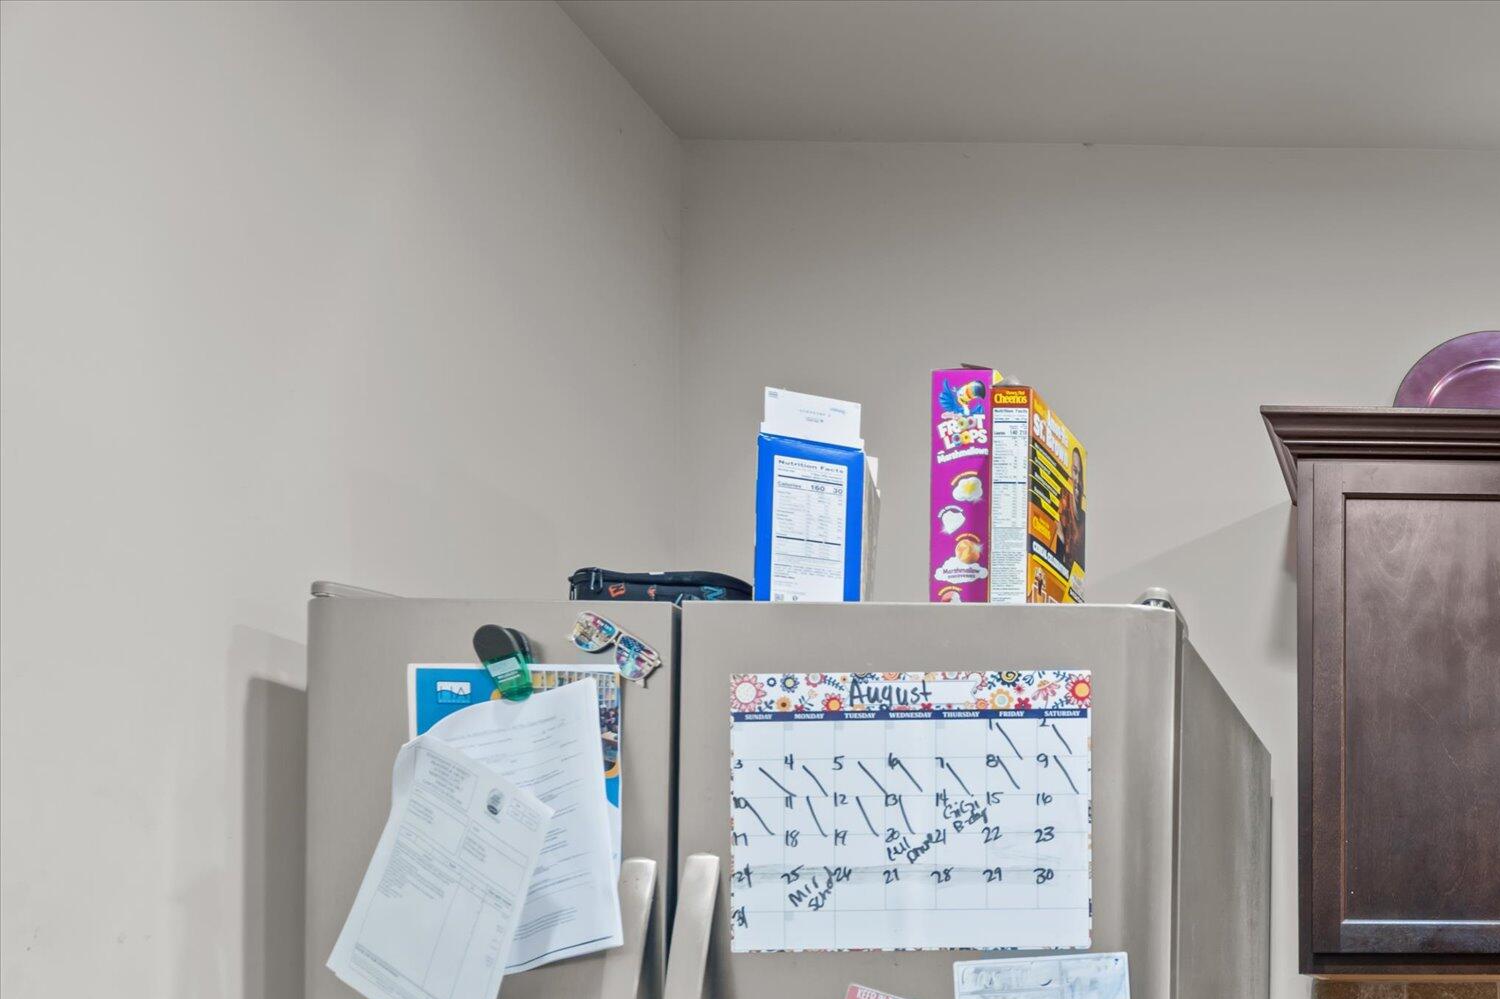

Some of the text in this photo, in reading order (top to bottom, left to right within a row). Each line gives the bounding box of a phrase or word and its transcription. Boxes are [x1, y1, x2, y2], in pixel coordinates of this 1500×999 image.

[994, 393, 1028, 404] Cheerios
[937, 413, 986, 439] FROOT
[943, 429, 988, 450] LOOPS
[778, 459, 844, 474] Nutrition Facts
[810, 484, 826, 492] 160
[850, 678, 932, 707] August
[733, 758, 744, 769] 3
[783, 753, 795, 771] 4
[832, 755, 845, 771] 5
[934, 756, 945, 769] 7
[985, 753, 1000, 768] 8
[1036, 752, 1049, 768] 9
[834, 792, 849, 807] 12
[884, 793, 899, 807] 13
[935, 788, 950, 807] 14
[986, 791, 1004, 805] 15
[1035, 792, 1053, 806] 16
[784, 829, 800, 848] 18
[834, 828, 849, 846] 19
[884, 827, 900, 842] 20
[934, 828, 946, 844] 21
[981, 825, 1003, 843] 22
[1034, 825, 1055, 843] 23
[731, 863, 753, 888] 24
[781, 864, 804, 885] 25
[834, 866, 853, 883] 26
[930, 866, 954, 884] 28
[982, 866, 1003, 882] 29
[1033, 867, 1055, 885] 30
